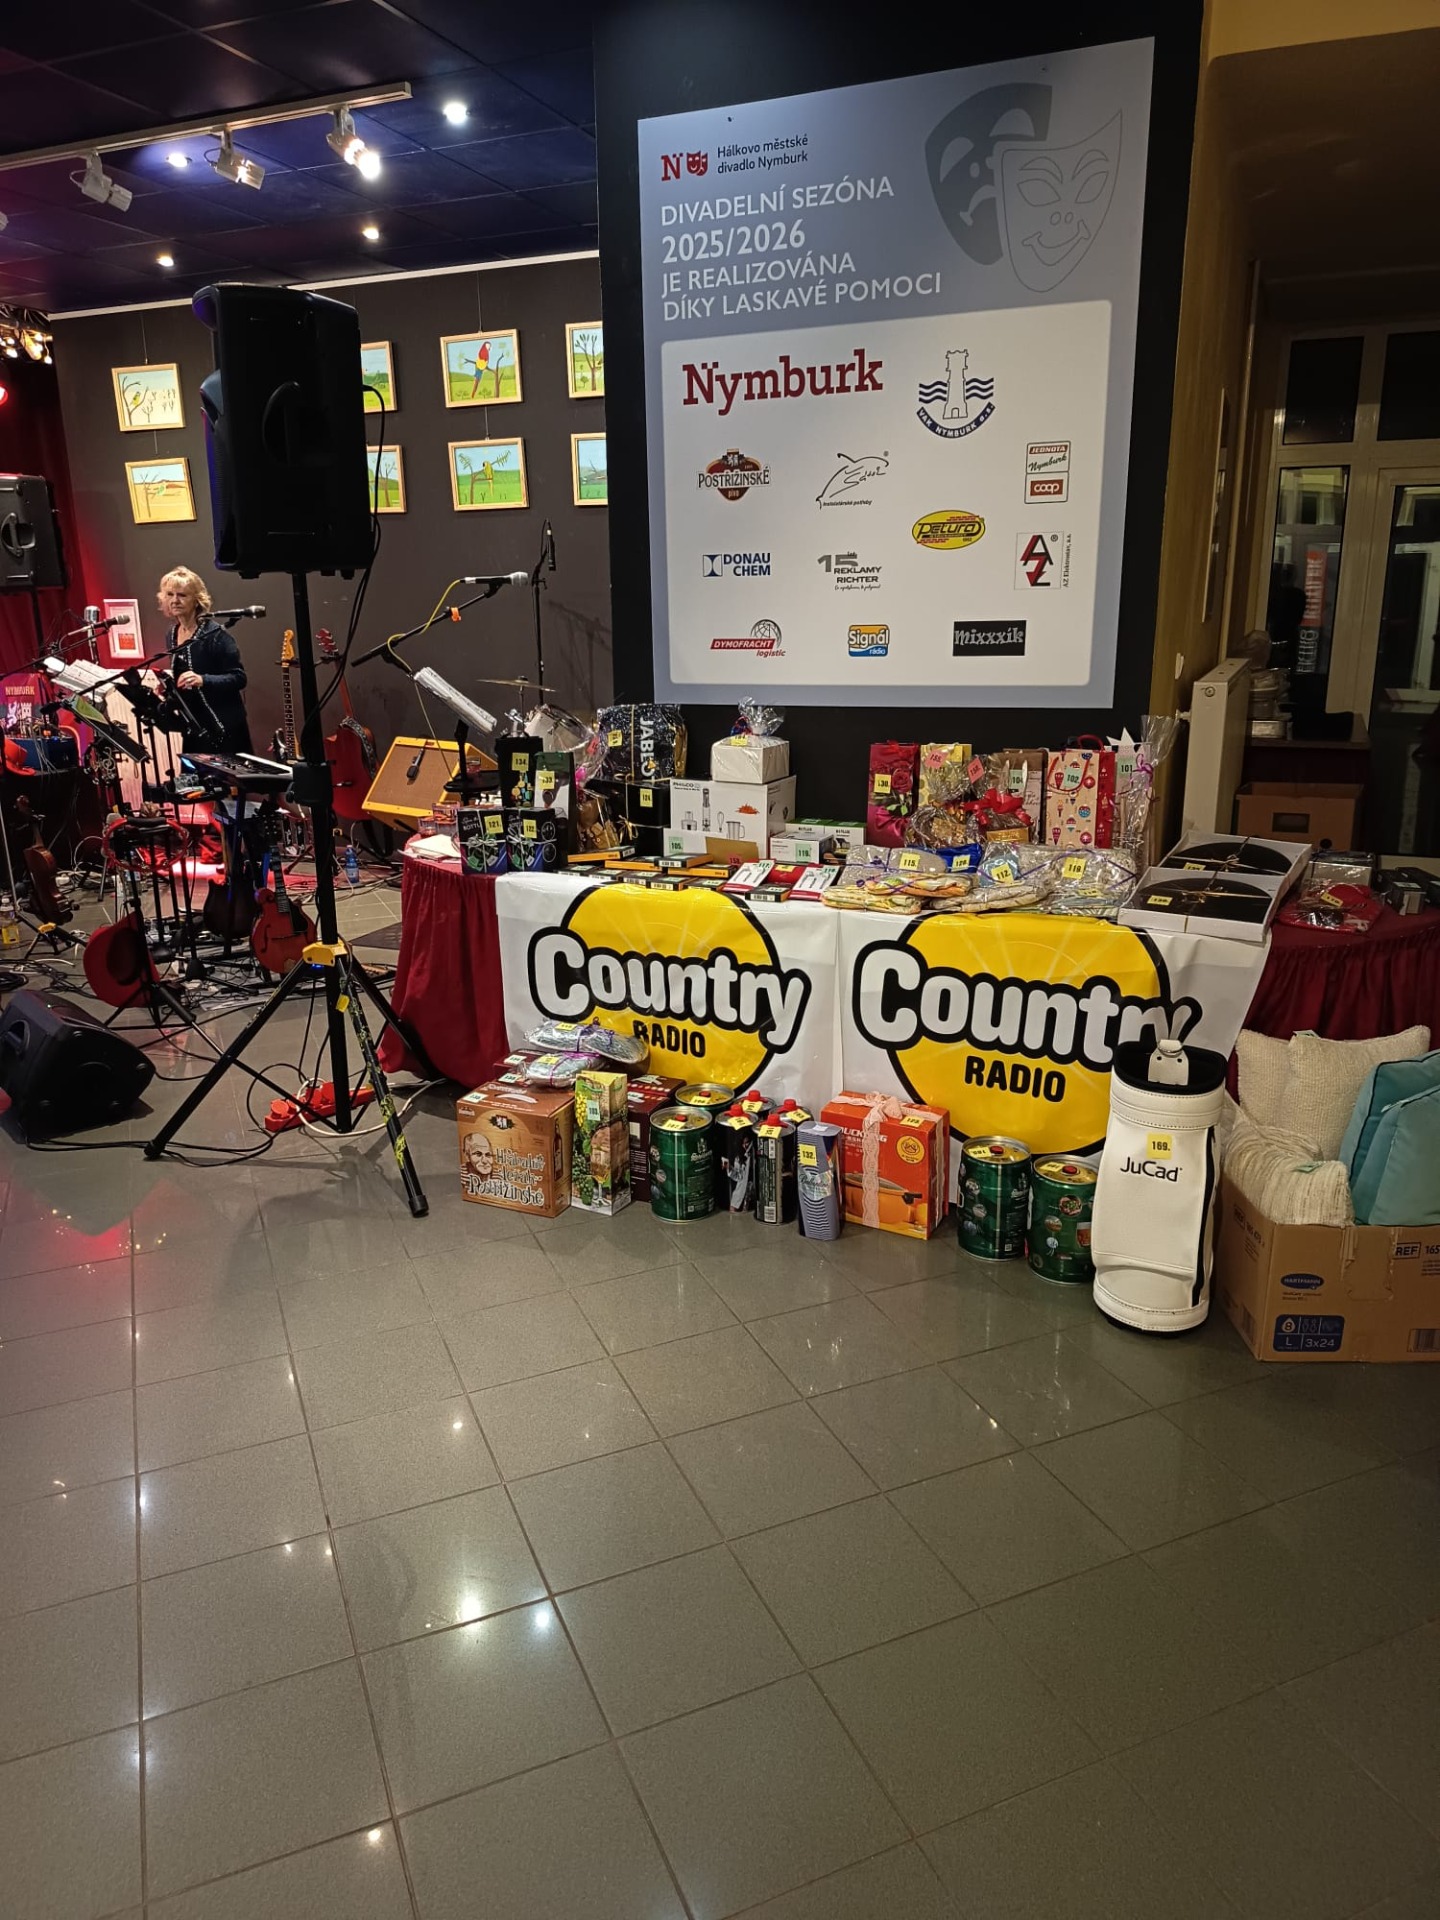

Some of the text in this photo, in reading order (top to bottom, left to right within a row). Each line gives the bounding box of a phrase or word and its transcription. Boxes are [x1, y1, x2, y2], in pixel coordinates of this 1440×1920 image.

[717, 134, 808, 159] Hálkovo městské
[717, 151, 808, 174] divadlo Nymburk
[662, 175, 895, 226] DIVADELNÍ SEZÓNA
[662, 219, 806, 264] 2025/2026
[661, 250, 856, 298] JE REALIZOVÁNA
[664, 272, 941, 321] DÍKY LASKAVÉ POMOCI
[682, 348, 883, 416] Nymburk
[919, 409, 933, 427] VAK
[935, 421, 977, 437] NYMBURK
[1030, 445, 1066, 453] JEDNOTA
[1029, 454, 1067, 471] Nymburk
[698, 465, 770, 488] POSTŘIŽINSKÉ
[723, 552, 771, 565] DONAU
[817, 554, 859, 573] 15
[733, 565, 771, 576] CHEM
[833, 566, 882, 574] REKLAMY
[836, 575, 879, 583] RICHTER
[714, 640, 773, 648] DYMOFRACHT
[849, 629, 888, 648] Signál
[756, 649, 786, 658] logistic
[1066, 774, 1080, 784] 102.
[533, 932, 806, 1048] Country
[632, 1019, 706, 1059] RADIO
[964, 1055, 1066, 1103] RADIO
[1151, 1140, 1171, 1151] 169.
[802, 1150, 816, 1160] 132.
[1120, 1157, 1180, 1182] JuCad
[1395, 1246, 1418, 1256] REF
[1284, 1321, 1292, 1332] 8
[1285, 1337, 1292, 1346] L
[1305, 1338, 1335, 1348] 3x24
